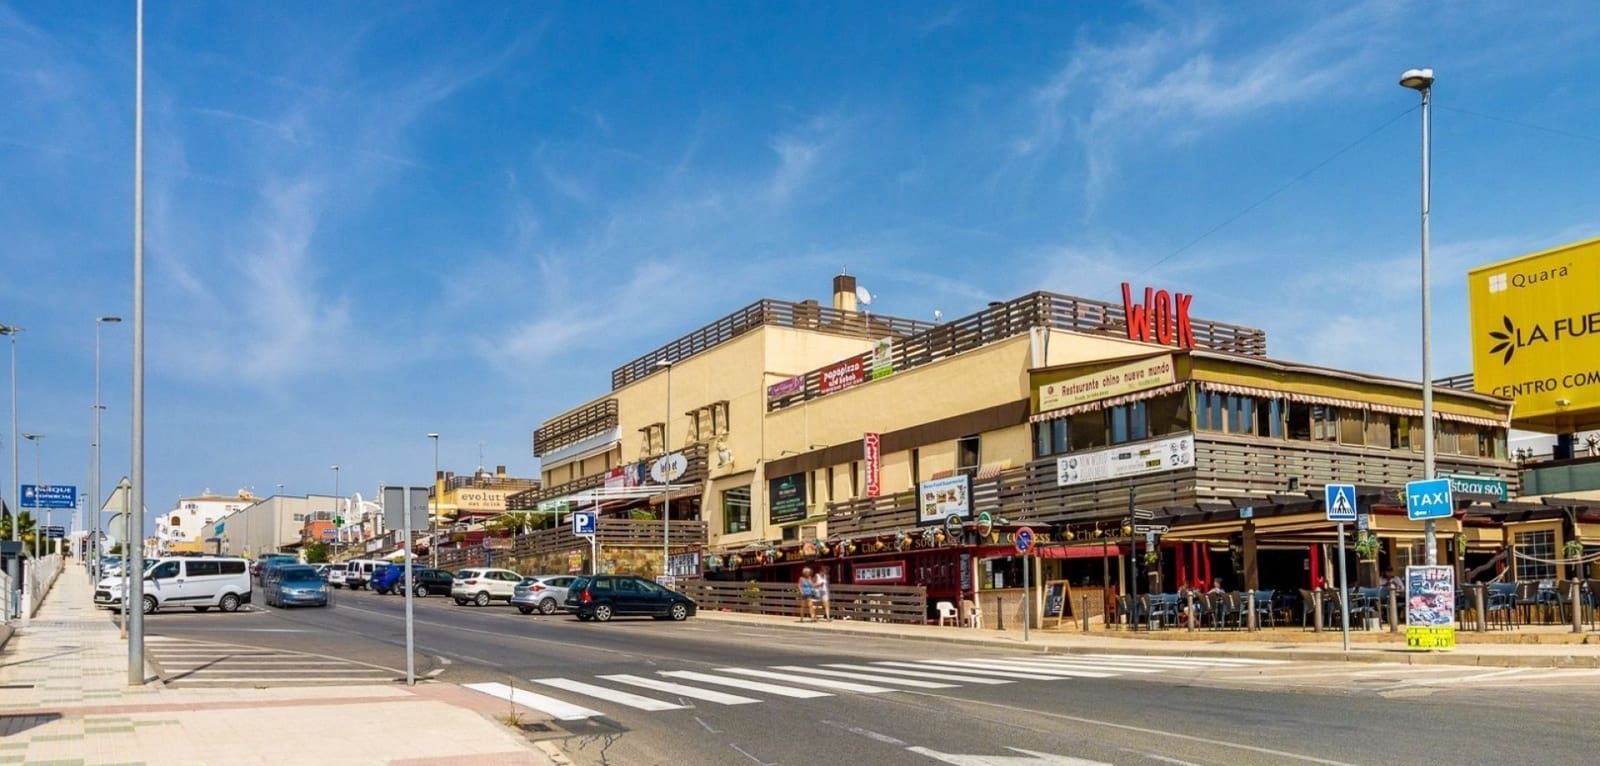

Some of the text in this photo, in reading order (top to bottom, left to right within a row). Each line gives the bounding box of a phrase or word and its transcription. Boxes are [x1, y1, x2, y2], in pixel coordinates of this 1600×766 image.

[1512, 265, 1568, 288] Quara
[1121, 282, 1194, 349] WOK
[1517, 312, 1600, 348] LA FUE
[1061, 379, 1099, 396] Restaurante
[1103, 374, 1120, 387] chino
[1124, 370, 1144, 381] nuevo
[1148, 362, 1169, 376] mundo
[1410, 491, 1448, 507] TAXI
[575, 514, 589, 533] P
